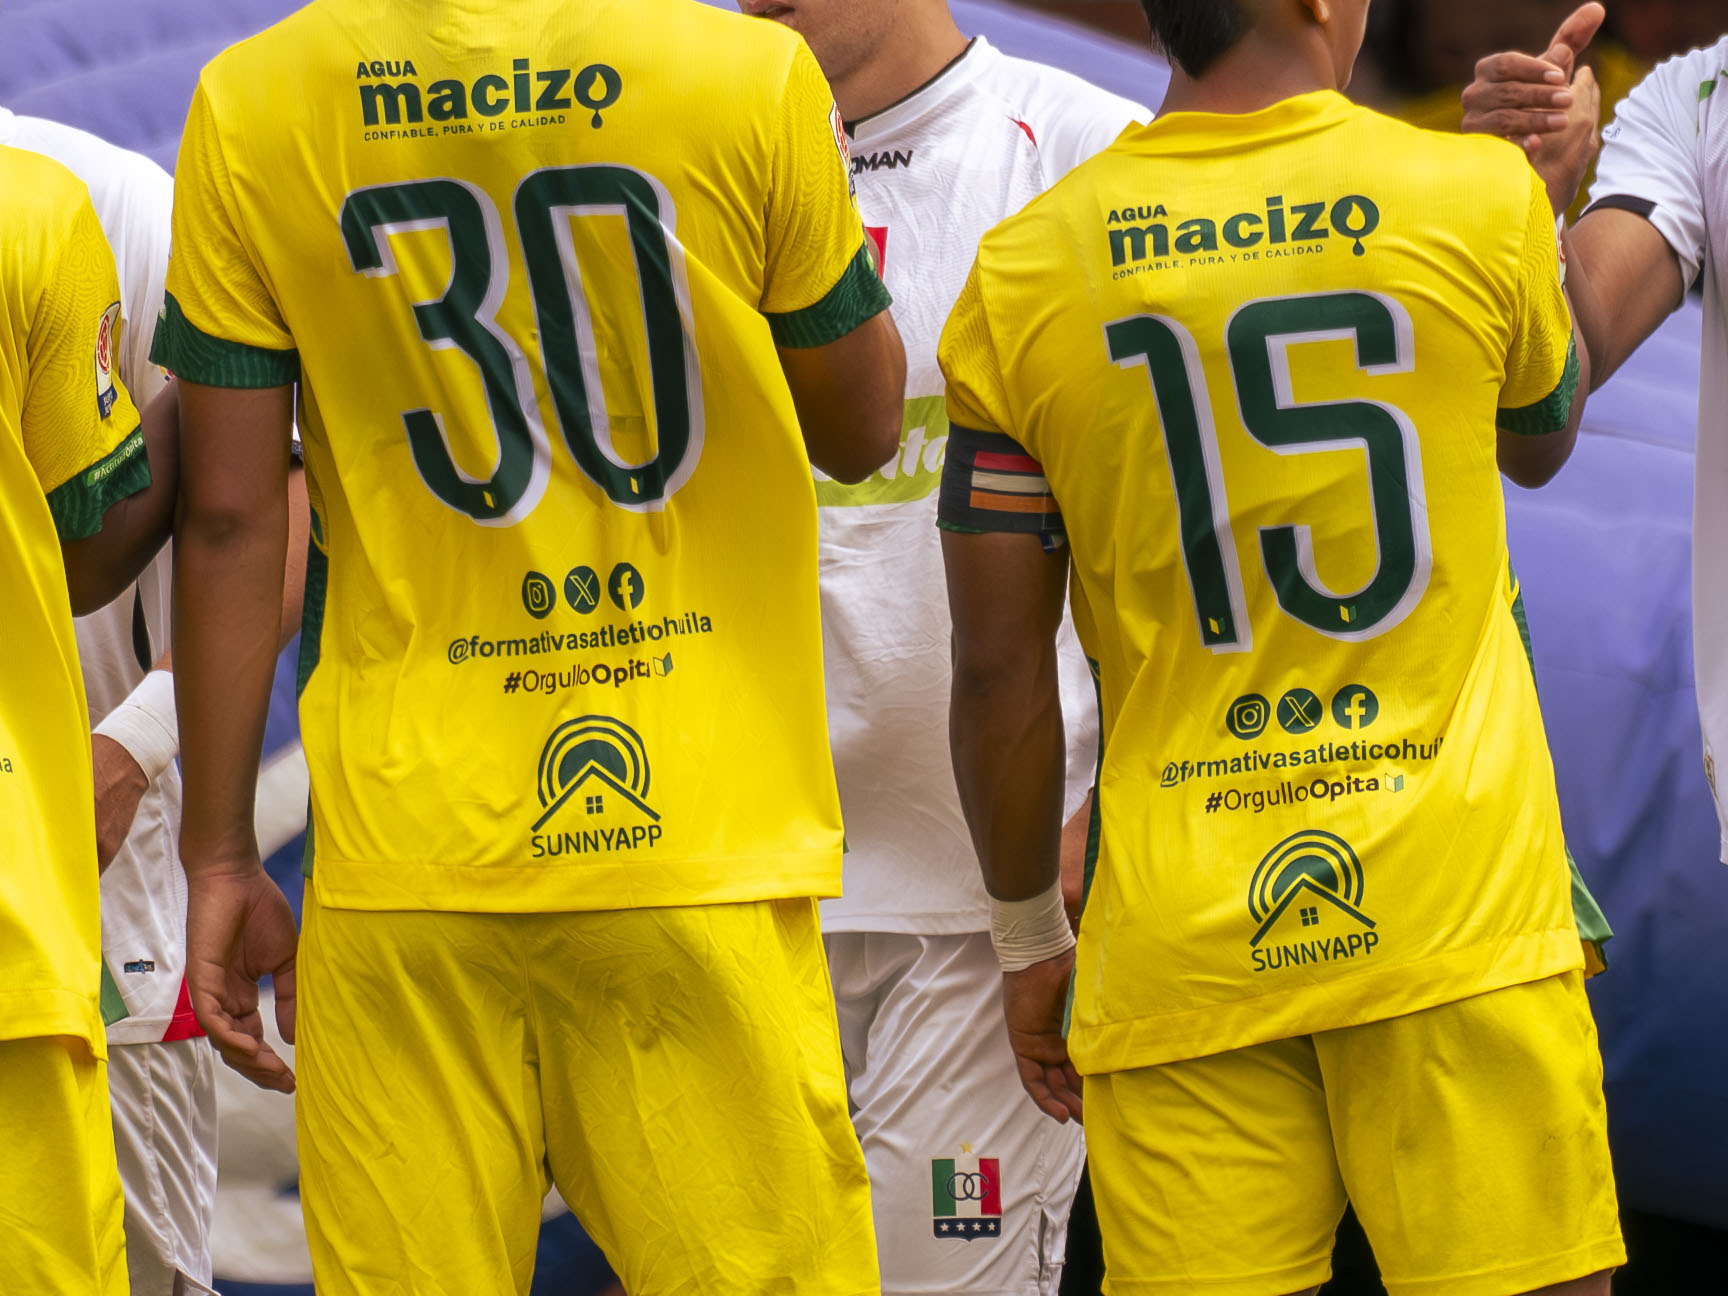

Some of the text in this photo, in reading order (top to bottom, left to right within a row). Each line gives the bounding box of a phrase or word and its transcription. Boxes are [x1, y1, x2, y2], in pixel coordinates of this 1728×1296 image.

[356, 60, 418, 80] AGUA
[358, 58, 622, 129] macizo
[443, 124, 474, 135] PURA
[477, 123, 485, 133] Y
[489, 121, 506, 132] DE
[511, 115, 566, 129] CALIDAD
[1107, 204, 1168, 225] AGUA
[1108, 194, 1380, 267] macizo
[1190, 256, 1225, 267] PURA
[1230, 254, 1237, 263] Y
[1243, 252, 1260, 262] DE
[1266, 244, 1324, 259] CALIDAD
[339, 163, 706, 529] 30
[1103, 290, 1433, 656] 15
[1205, 774, 1380, 814] #OrgulloOpita
[531, 824, 663, 858] SUNNYAPP
[1251, 931, 1379, 972] SUNNYAPP
